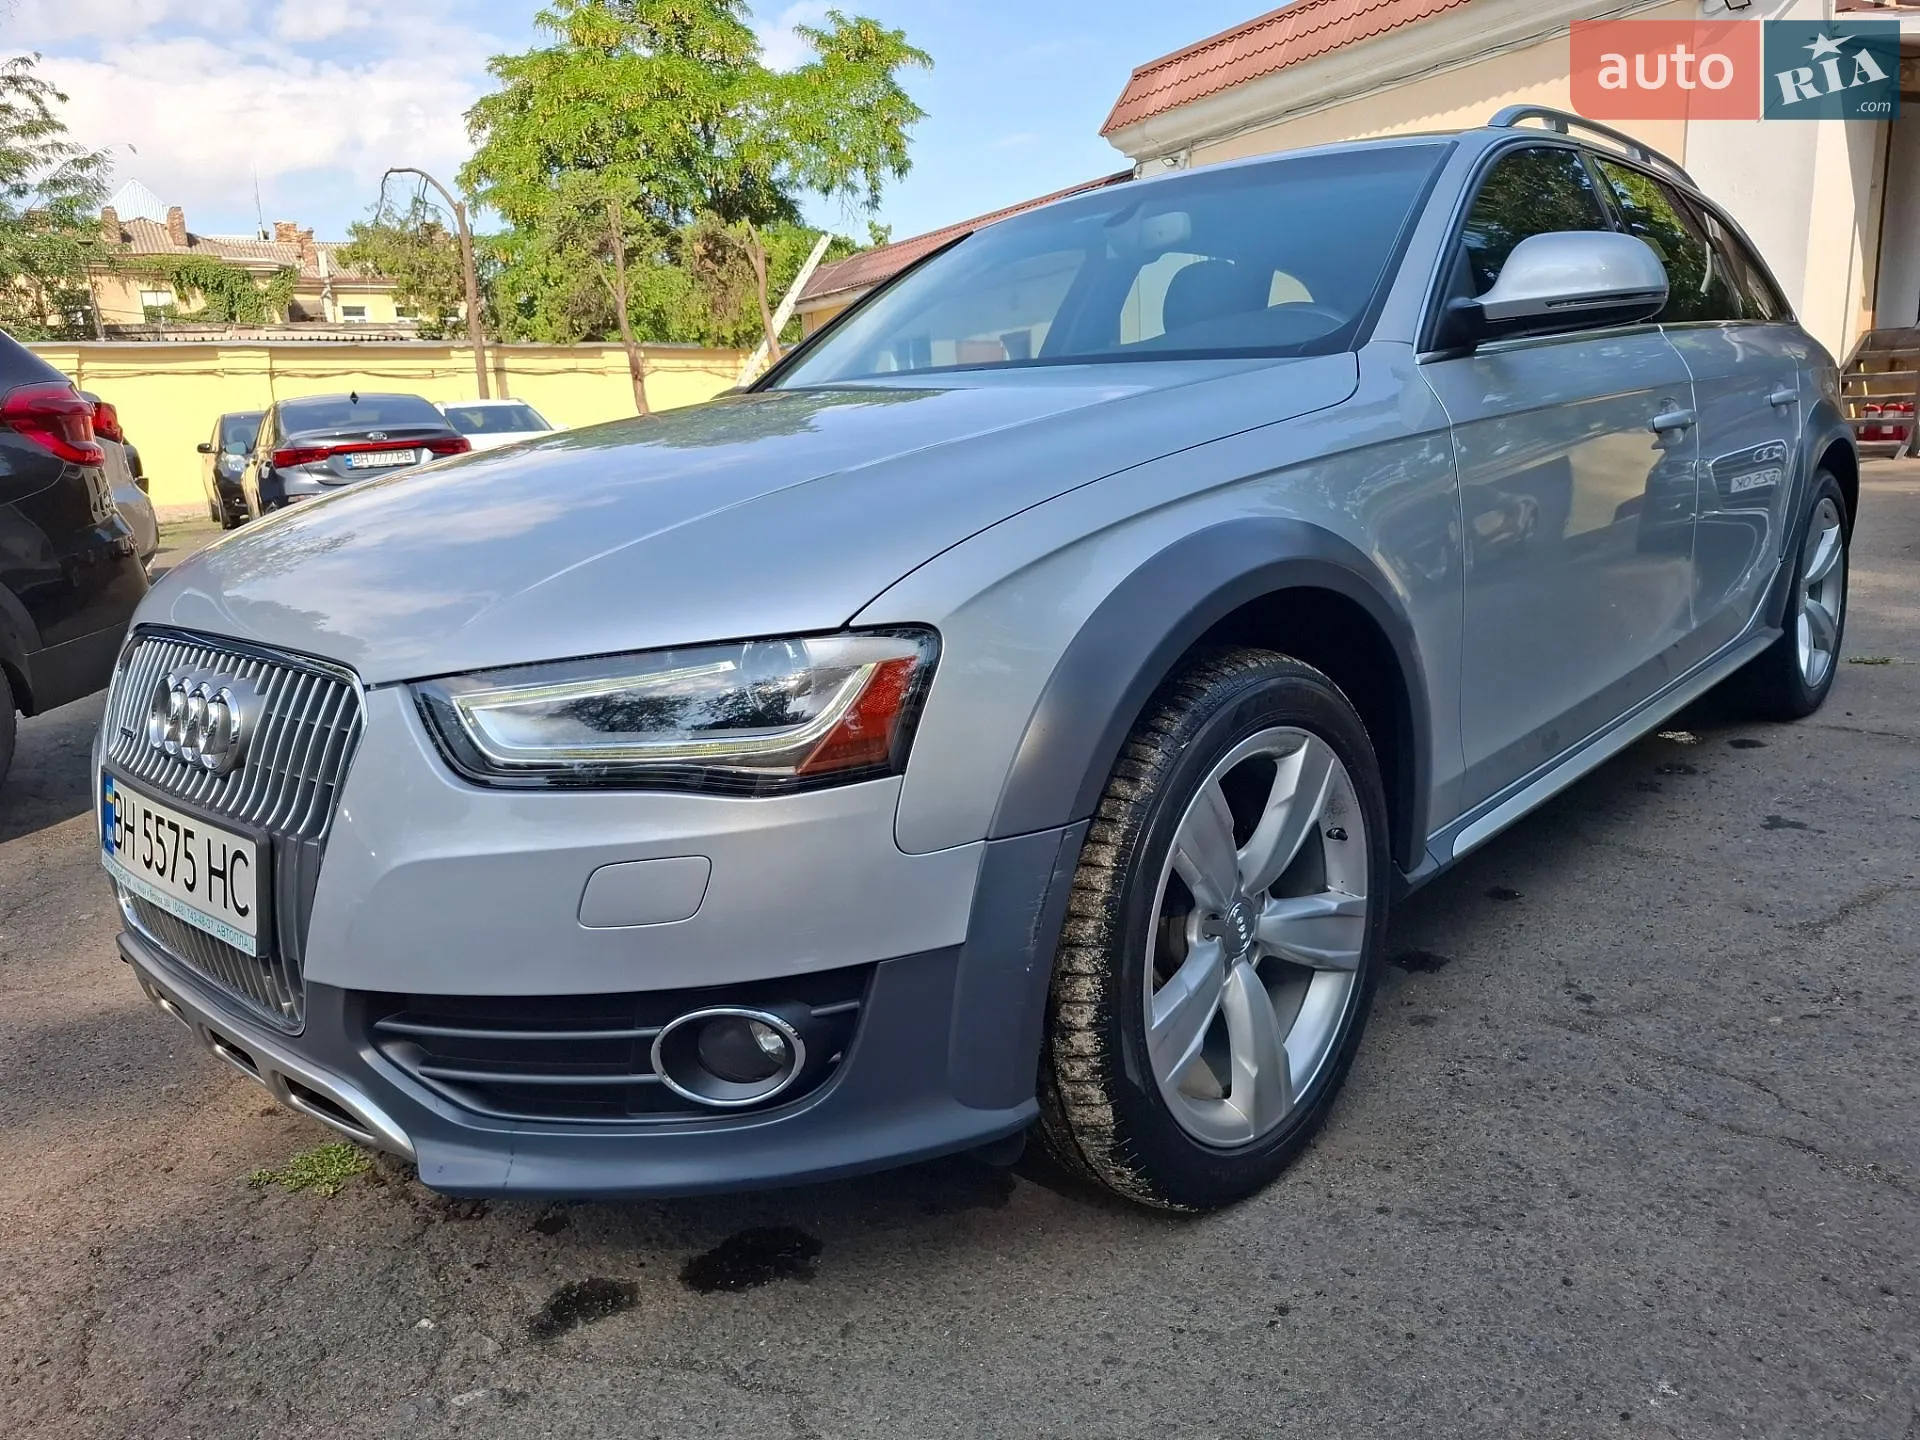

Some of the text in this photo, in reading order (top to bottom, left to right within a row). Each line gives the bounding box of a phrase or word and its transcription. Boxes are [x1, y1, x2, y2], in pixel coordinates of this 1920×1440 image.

[113, 790, 136, 861] BH
[142, 808, 197, 892] 5575
[207, 838, 250, 917] HC
